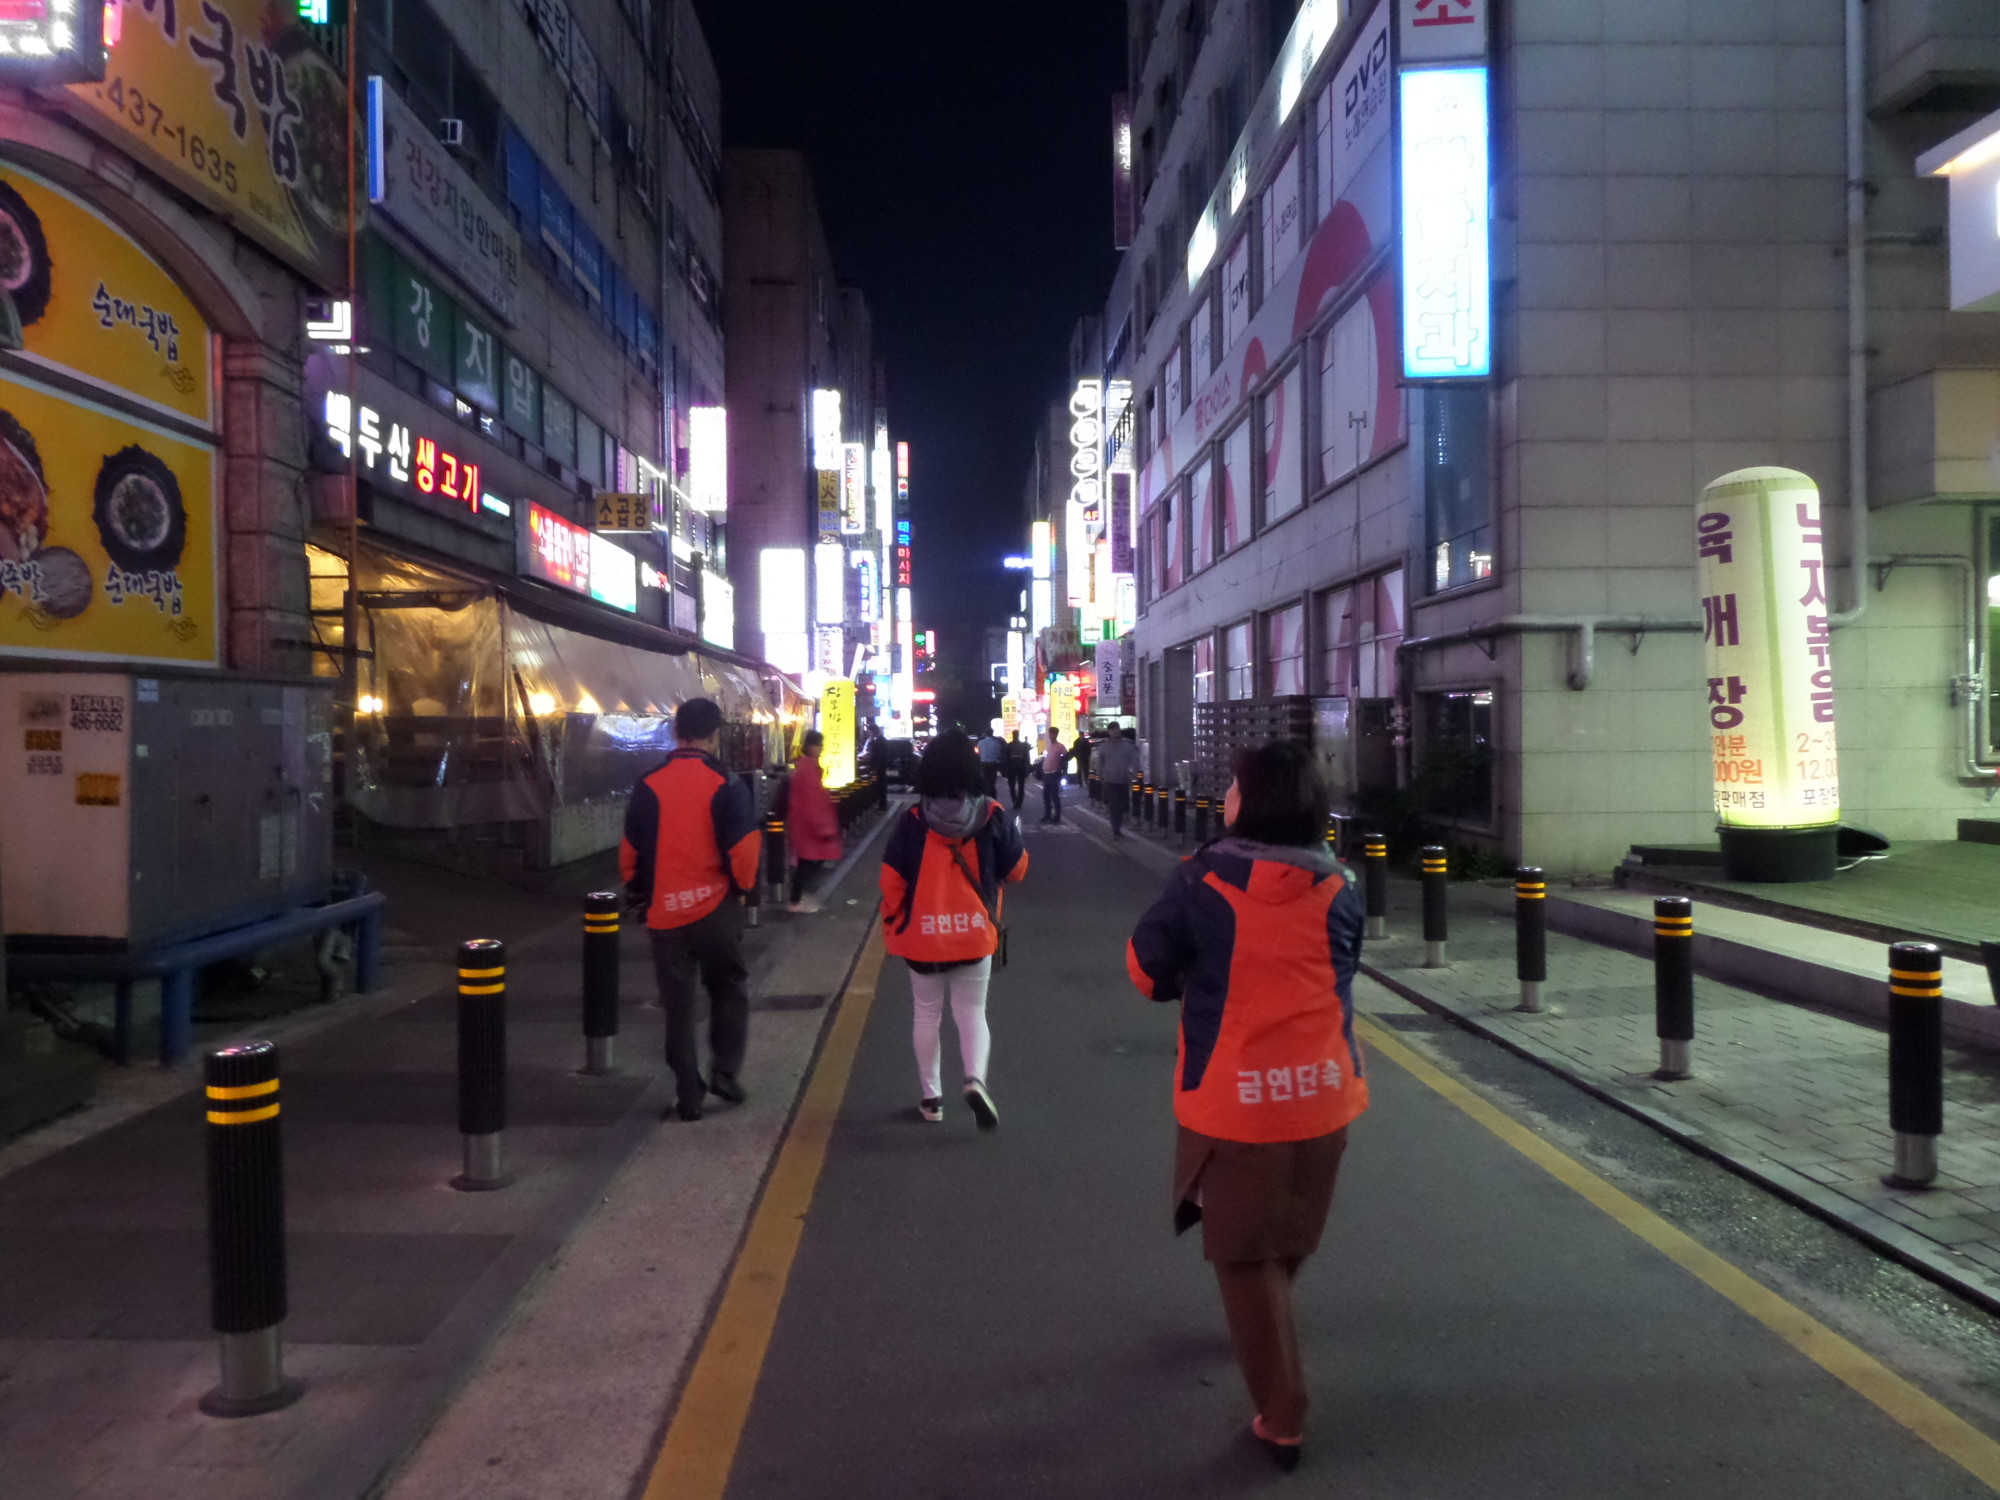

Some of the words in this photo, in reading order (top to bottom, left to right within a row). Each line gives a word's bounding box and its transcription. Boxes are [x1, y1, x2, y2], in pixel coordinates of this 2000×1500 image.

[142, 0, 300, 182] 국밥
[92, 281, 180, 362] 순대국밥
[0, 562, 48, 601] 족발
[104, 564, 183, 615] 순대국밥
[1697, 511, 1747, 730] 육개장
[921, 911, 986, 935] 금연단속
[1237, 1058, 1342, 1105] 금연단속
